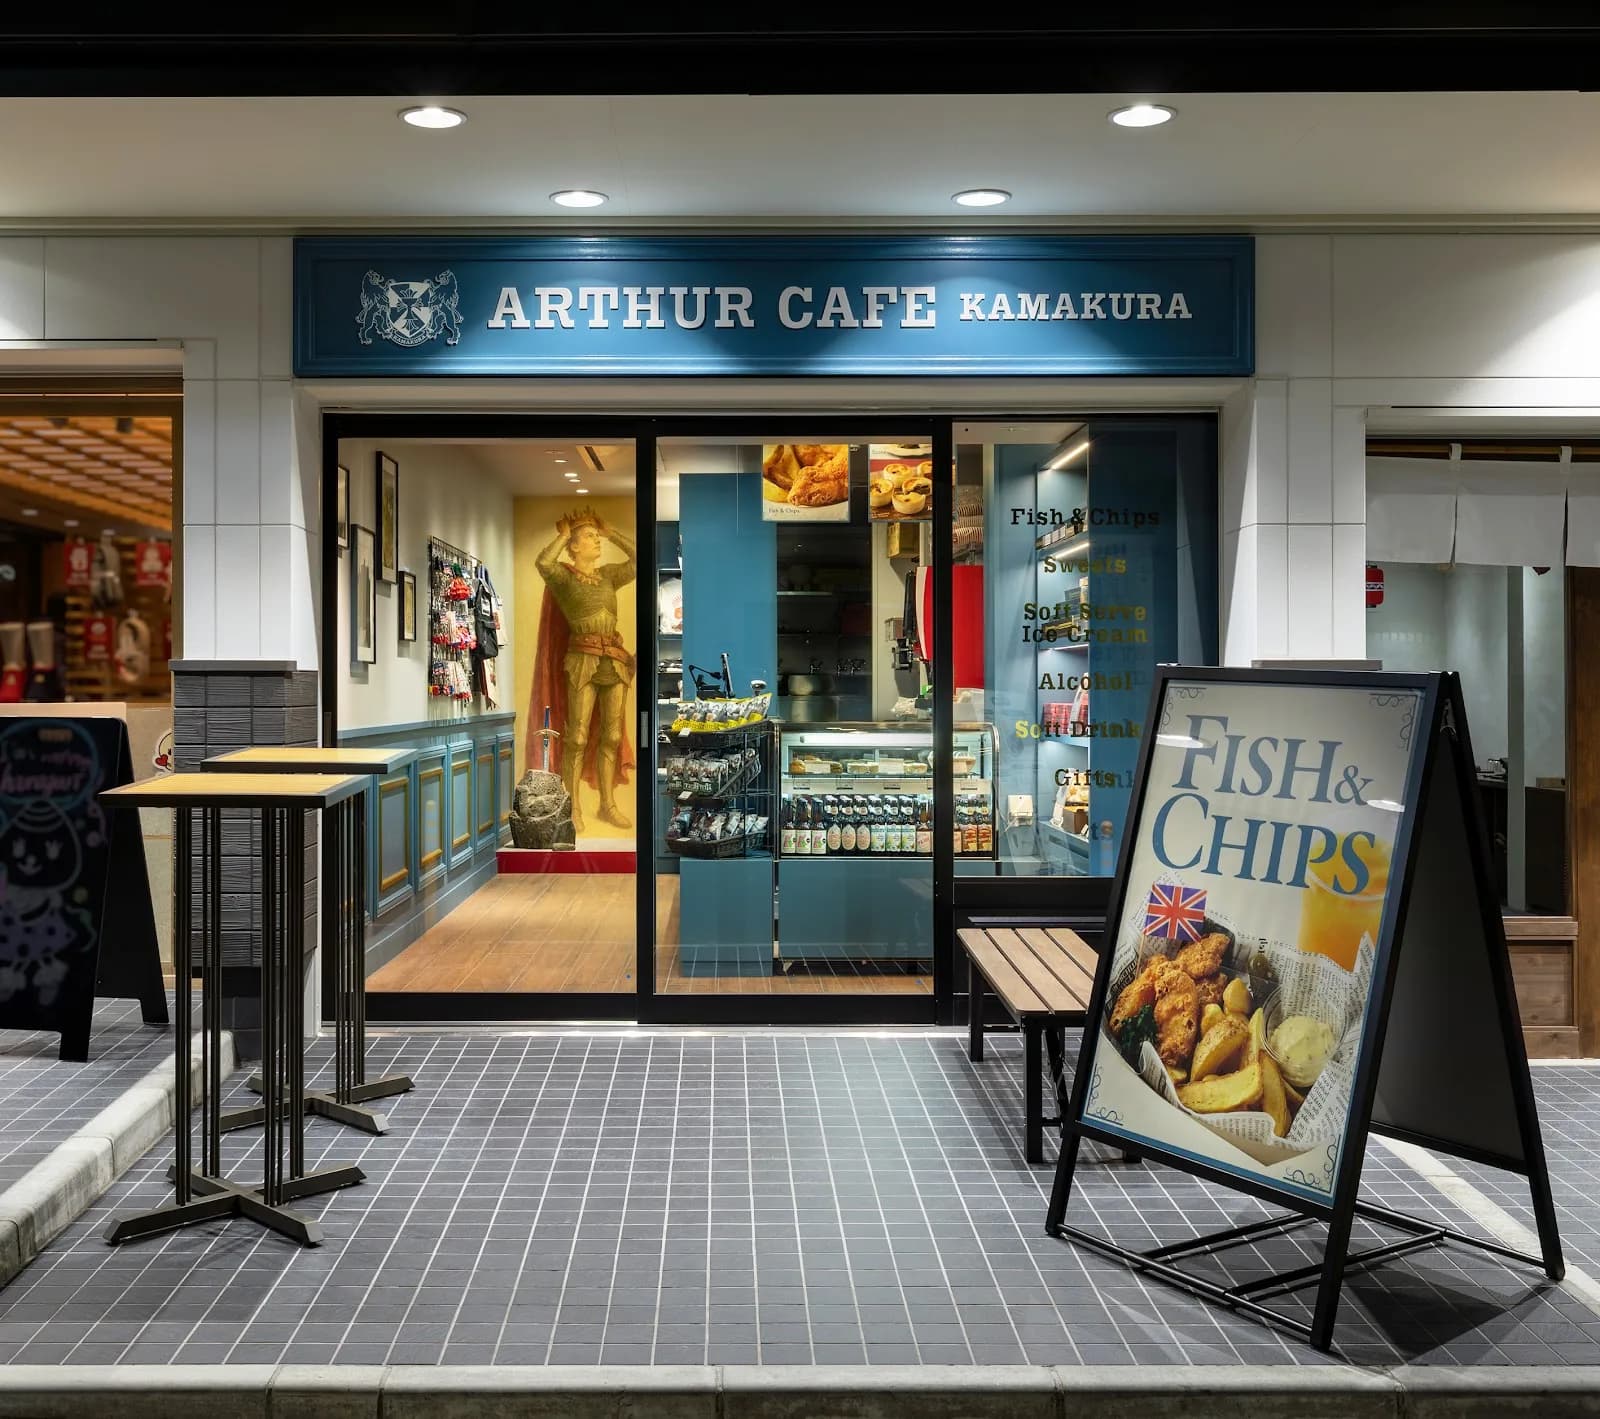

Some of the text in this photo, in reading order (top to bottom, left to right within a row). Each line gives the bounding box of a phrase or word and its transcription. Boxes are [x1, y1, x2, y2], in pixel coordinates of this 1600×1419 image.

[488, 286, 1192, 329] ARTHUR CAFE KAMAKURA
[1010, 508, 1161, 529] Fish & Chips
[1044, 556, 1128, 575] Sweets
[1024, 602, 1148, 622] Soft Serve
[1022, 626, 1148, 644] Ice Cream
[1039, 673, 1134, 691] Alcohol
[1015, 719, 1061, 739] Soft
[1054, 768, 1116, 788] Gifts
[1152, 793, 1376, 895] CHIPS
